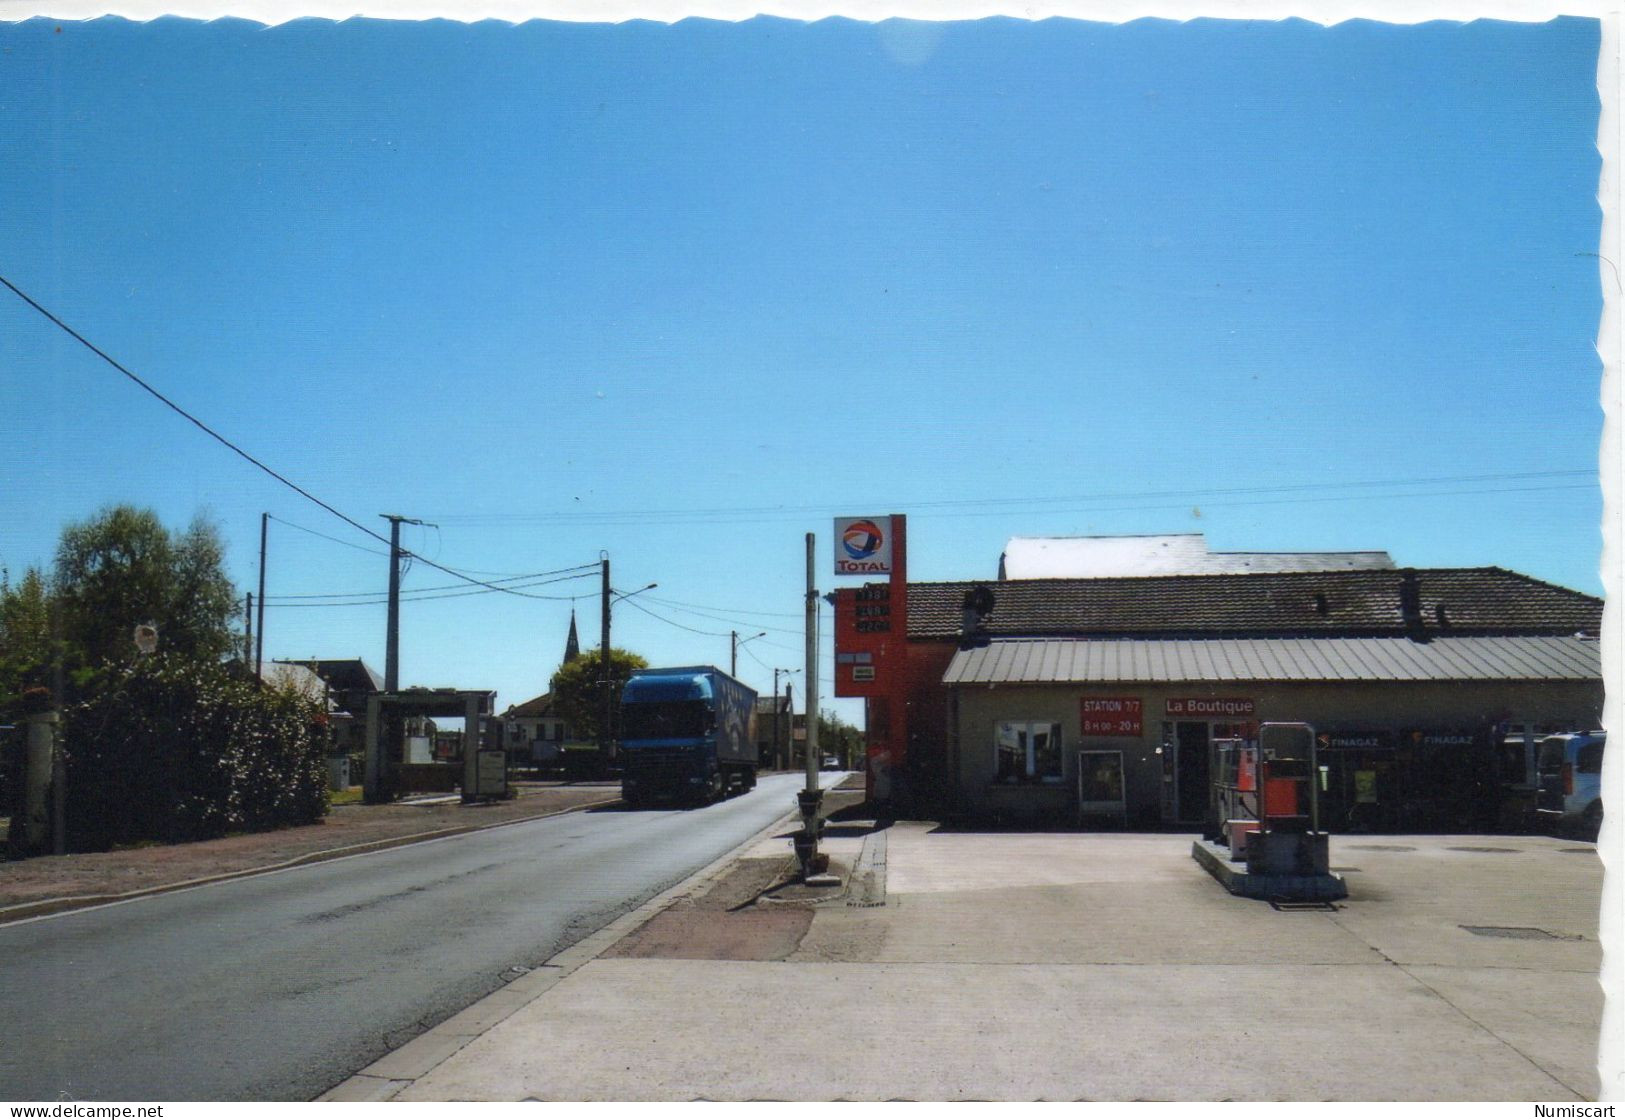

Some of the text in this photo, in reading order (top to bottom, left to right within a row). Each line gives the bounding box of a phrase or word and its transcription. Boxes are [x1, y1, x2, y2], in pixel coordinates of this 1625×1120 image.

[837, 560, 889, 571] TOTAL
[1084, 700, 1140, 711] STATION 7/7
[1166, 700, 1253, 715] La Boutique
[1331, 738, 1378, 747] FINAGAZ
[1424, 736, 1473, 745] FINAGAZ
